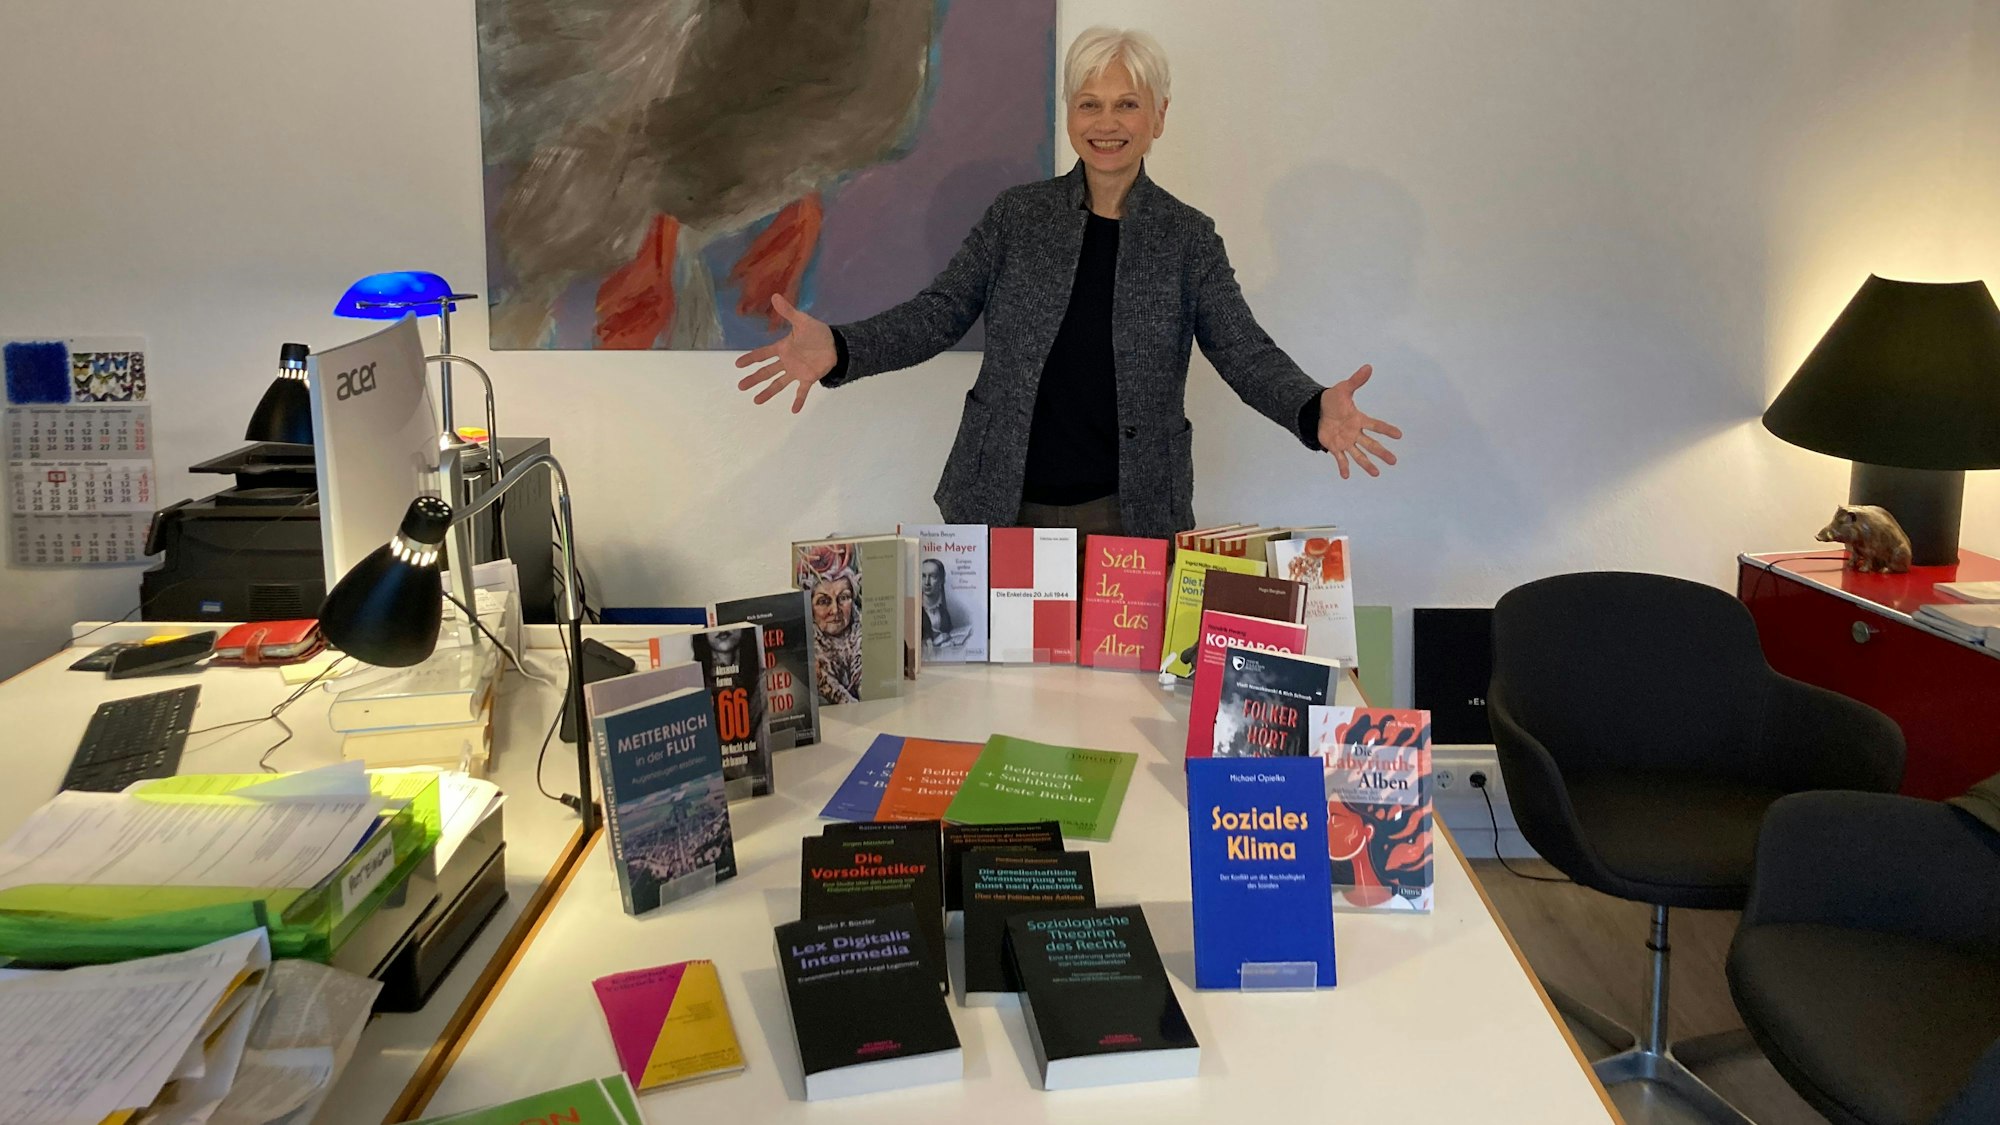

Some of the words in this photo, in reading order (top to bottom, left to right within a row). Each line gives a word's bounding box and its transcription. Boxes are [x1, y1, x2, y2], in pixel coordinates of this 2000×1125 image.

[337, 361, 376, 401] acer
[923, 543, 942, 553] milie
[945, 543, 976, 556] Mayer
[1102, 548, 1146, 570] Sieh
[1096, 574, 1124, 600] da,
[1183, 576, 1197, 587] Die
[1182, 587, 1198, 596] von
[1114, 605, 1148, 630] das
[764, 629, 784, 648] KER
[1094, 634, 1144, 658] Alter
[766, 672, 792, 691] LIED
[769, 694, 794, 712] TOD
[1283, 690, 1294, 698] Rich
[718, 687, 750, 741] 66
[1244, 699, 1298, 728] FOLKER
[618, 714, 708, 754] METTERNICH
[1247, 722, 1288, 750] HÖRT
[597, 732, 606, 756] FLUT
[636, 754, 646, 768] in
[647, 750, 664, 764] der
[666, 734, 697, 758] FLUT
[1354, 746, 1372, 757] Die
[923, 767, 970, 777] Belletr
[1324, 752, 1415, 774] Labyrinth-
[920, 776, 965, 786] Sachb
[999, 772, 1072, 790] Sachbuch
[1003, 764, 1083, 783] Belletristik
[1230, 774, 1256, 783] Michael
[1258, 774, 1285, 784] Opielka
[1358, 772, 1408, 790] Alben
[918, 786, 958, 797] Beste
[994, 783, 1036, 798] Beste
[1039, 790, 1094, 804] Bücher
[1212, 806, 1308, 830] Soziales
[1227, 836, 1296, 860] Klima
[855, 854, 882, 865] Die
[811, 864, 926, 880] Vorsokratiker
[981, 876, 1054, 884] Verantwortung
[996, 869, 1076, 877] gesellschaftliche
[1400, 888, 1422, 896] Dittric
[1027, 915, 1129, 931] Soziologische
[1049, 928, 1115, 940] Theorien
[792, 942, 827, 957] Lex
[833, 930, 911, 949] Digitalis
[1046, 941, 1072, 952] des
[1076, 939, 1127, 951] Rechts
[801, 945, 910, 970] Intermedia
